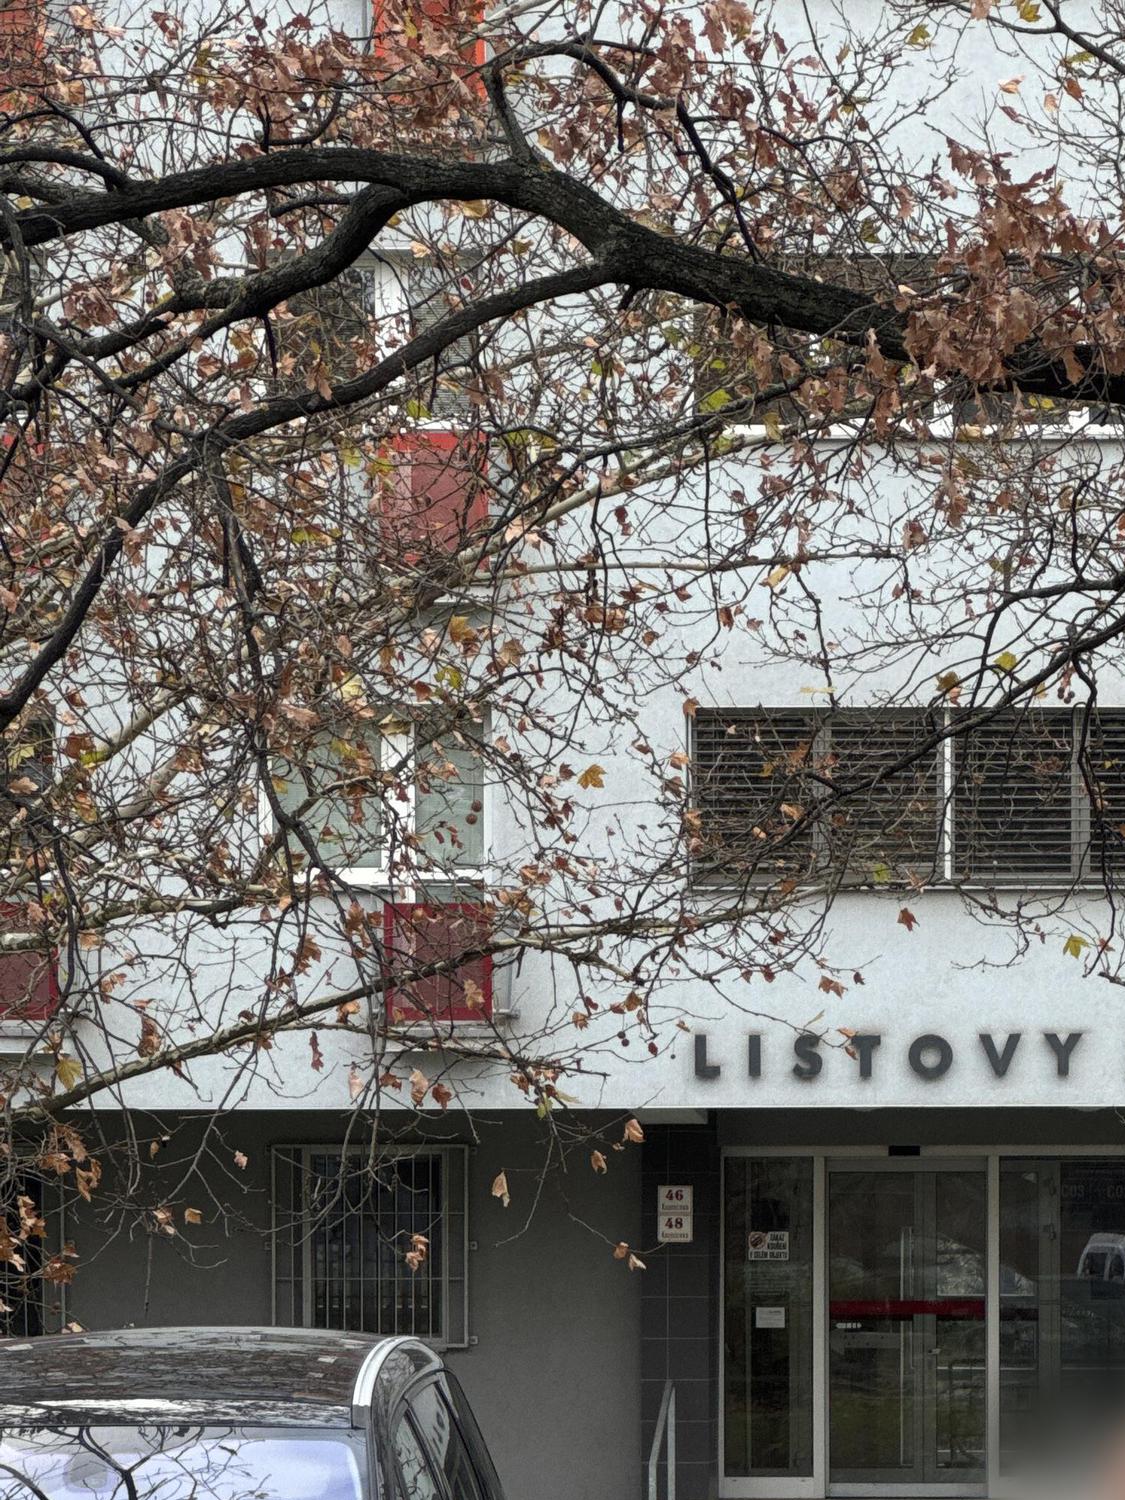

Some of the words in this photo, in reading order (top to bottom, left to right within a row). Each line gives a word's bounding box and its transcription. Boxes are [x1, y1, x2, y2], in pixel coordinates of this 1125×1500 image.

[694, 1032, 1082, 1079] LISTOVY
[665, 1189, 684, 1201] 46
[664, 1217, 683, 1229] 48
